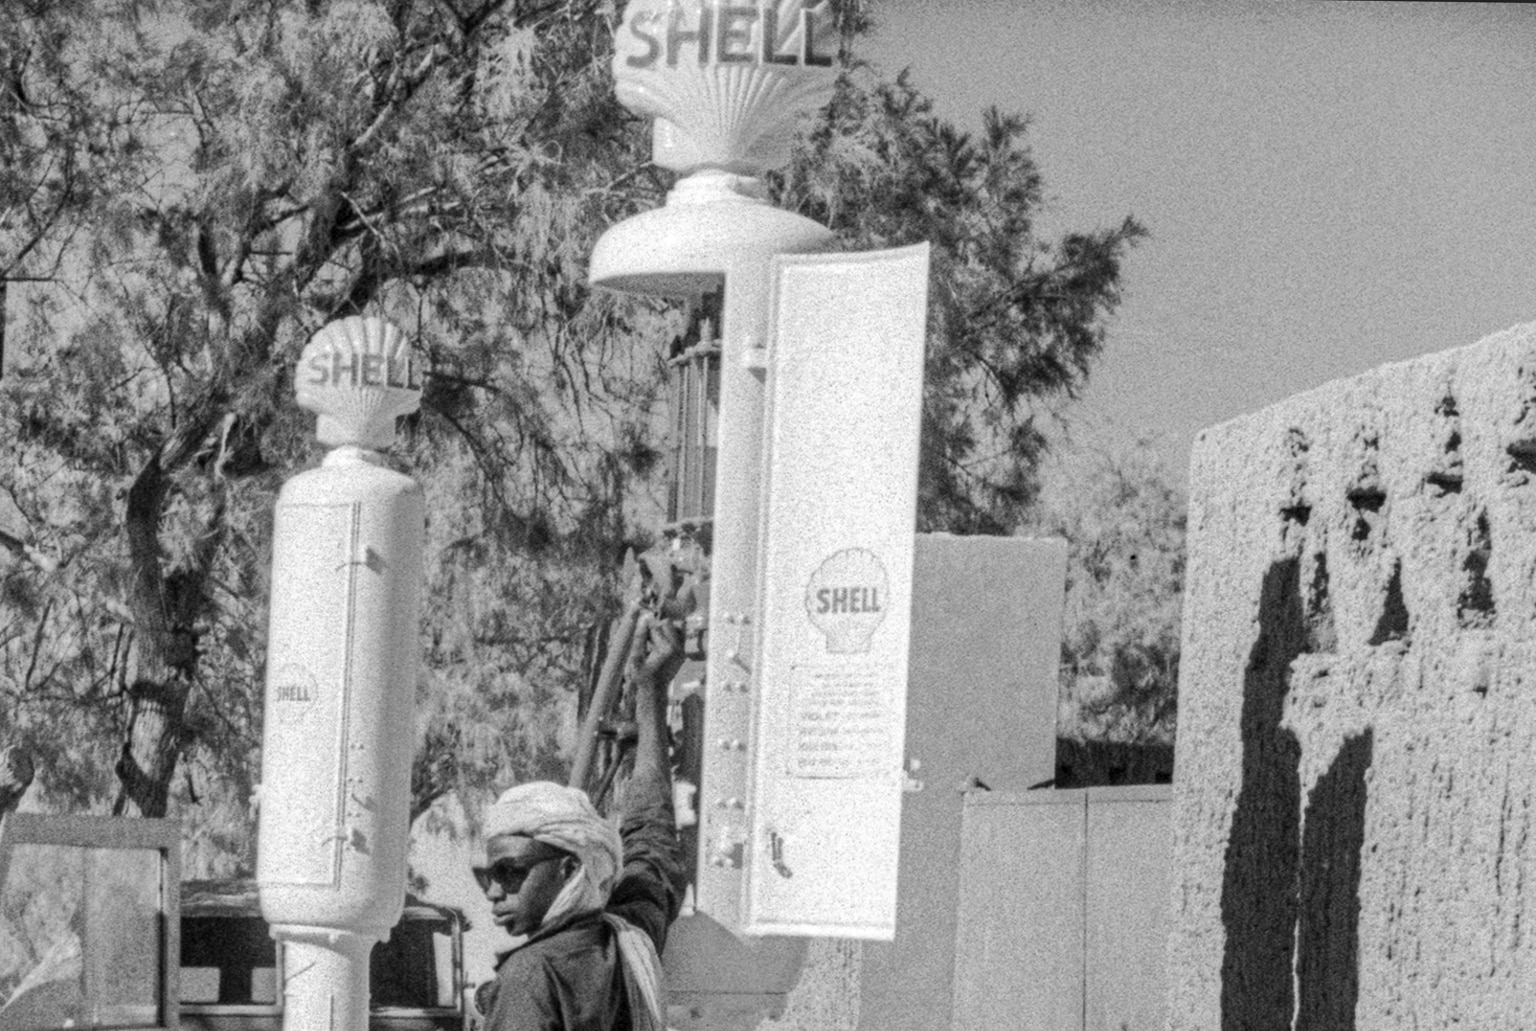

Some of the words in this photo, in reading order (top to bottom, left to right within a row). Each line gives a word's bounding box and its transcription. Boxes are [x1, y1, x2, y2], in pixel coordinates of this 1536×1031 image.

[626, 7, 832, 68] SHELL
[307, 353, 421, 391] SHELL
[816, 587, 882, 614] SHELL
[276, 685, 311, 702] SHELL
